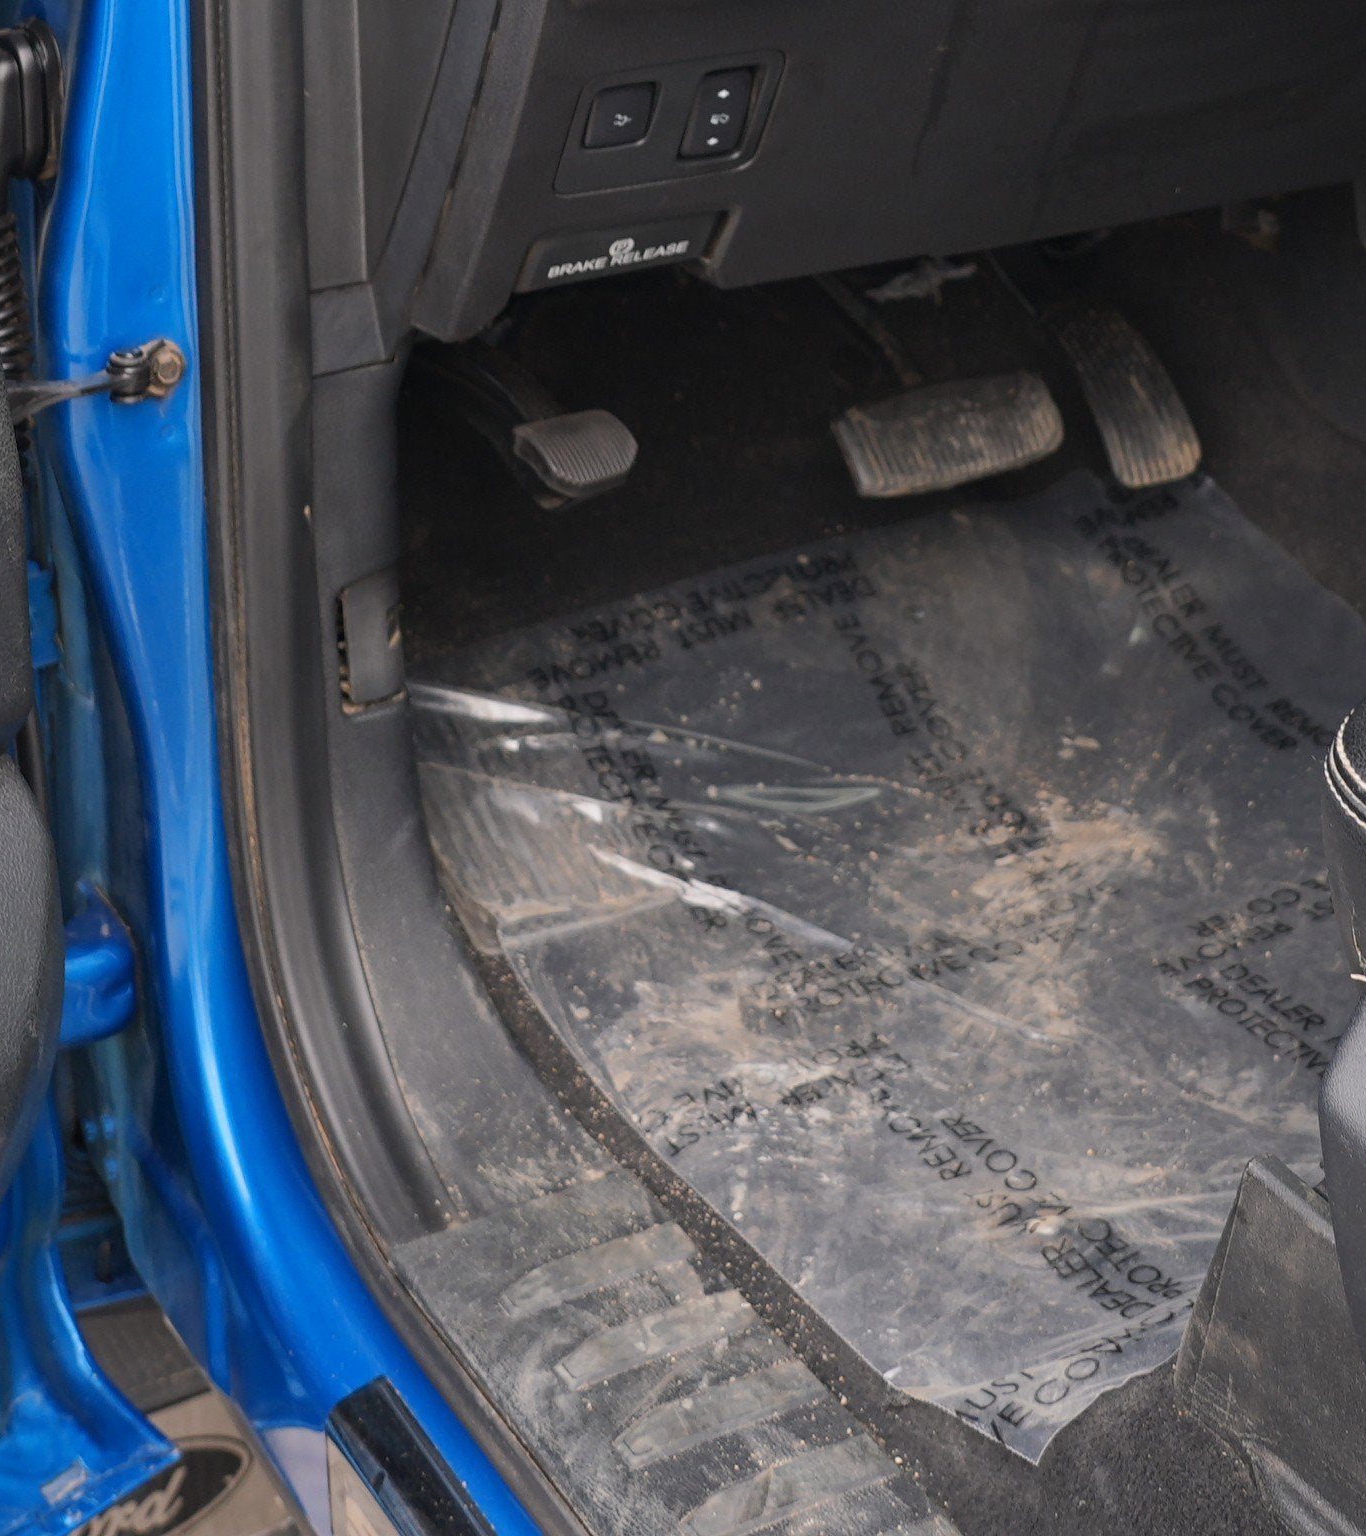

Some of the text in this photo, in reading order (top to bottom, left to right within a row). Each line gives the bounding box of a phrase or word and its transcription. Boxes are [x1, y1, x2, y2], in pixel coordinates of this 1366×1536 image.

[547, 239, 690, 280] BRAKE RELEASE
[833, 614, 918, 737] REMOVE
[1201, 623, 1270, 691] MUST
[1264, 697, 1336, 748] REMO
[1211, 681, 1298, 751] COVER
[1188, 887, 1302, 938] COER
[1184, 977, 1331, 1078] PROTECTIV
[1219, 963, 1326, 1032] DEALER
[940, 1113, 1038, 1192] COVER
[1041, 1237, 1156, 1321] DEALER
